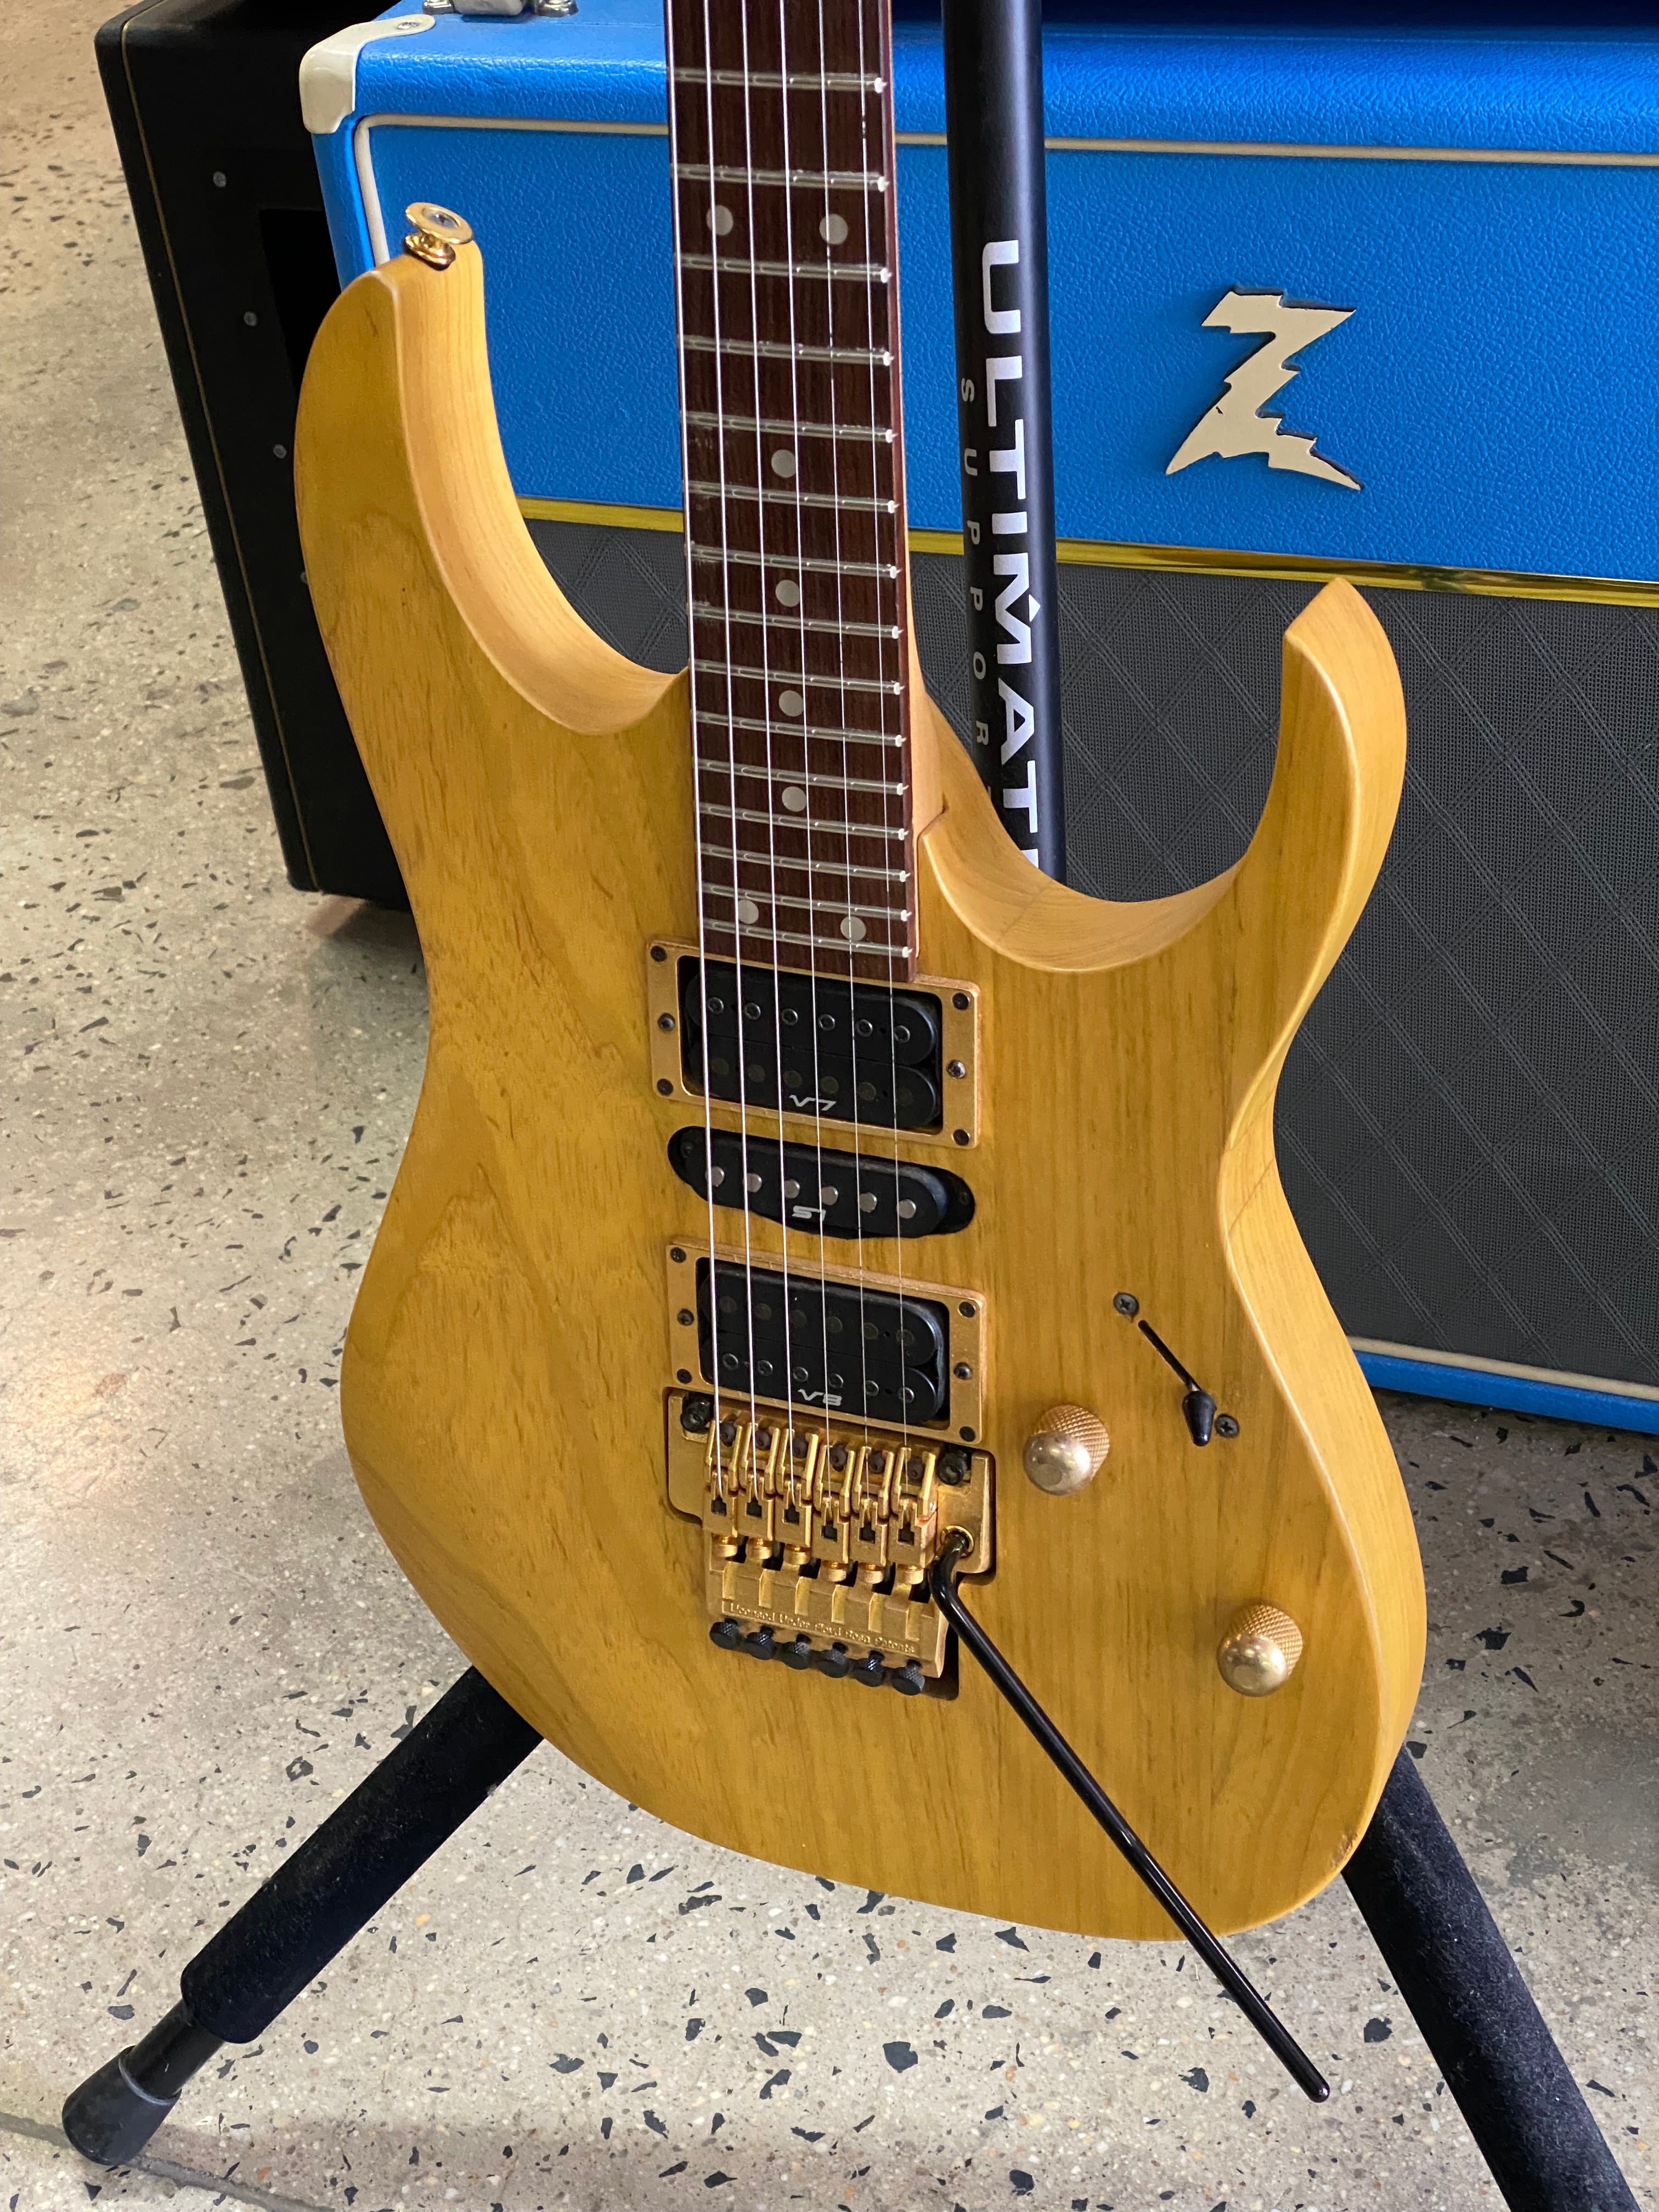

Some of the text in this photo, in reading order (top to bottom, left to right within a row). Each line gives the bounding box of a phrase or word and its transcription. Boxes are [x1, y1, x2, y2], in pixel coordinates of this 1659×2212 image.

[961, 379, 991, 800] SUPPOR
[983, 239, 1041, 869] ULTIMAT
[789, 1094, 837, 1111] V7
[797, 1388, 843, 1407] V8
